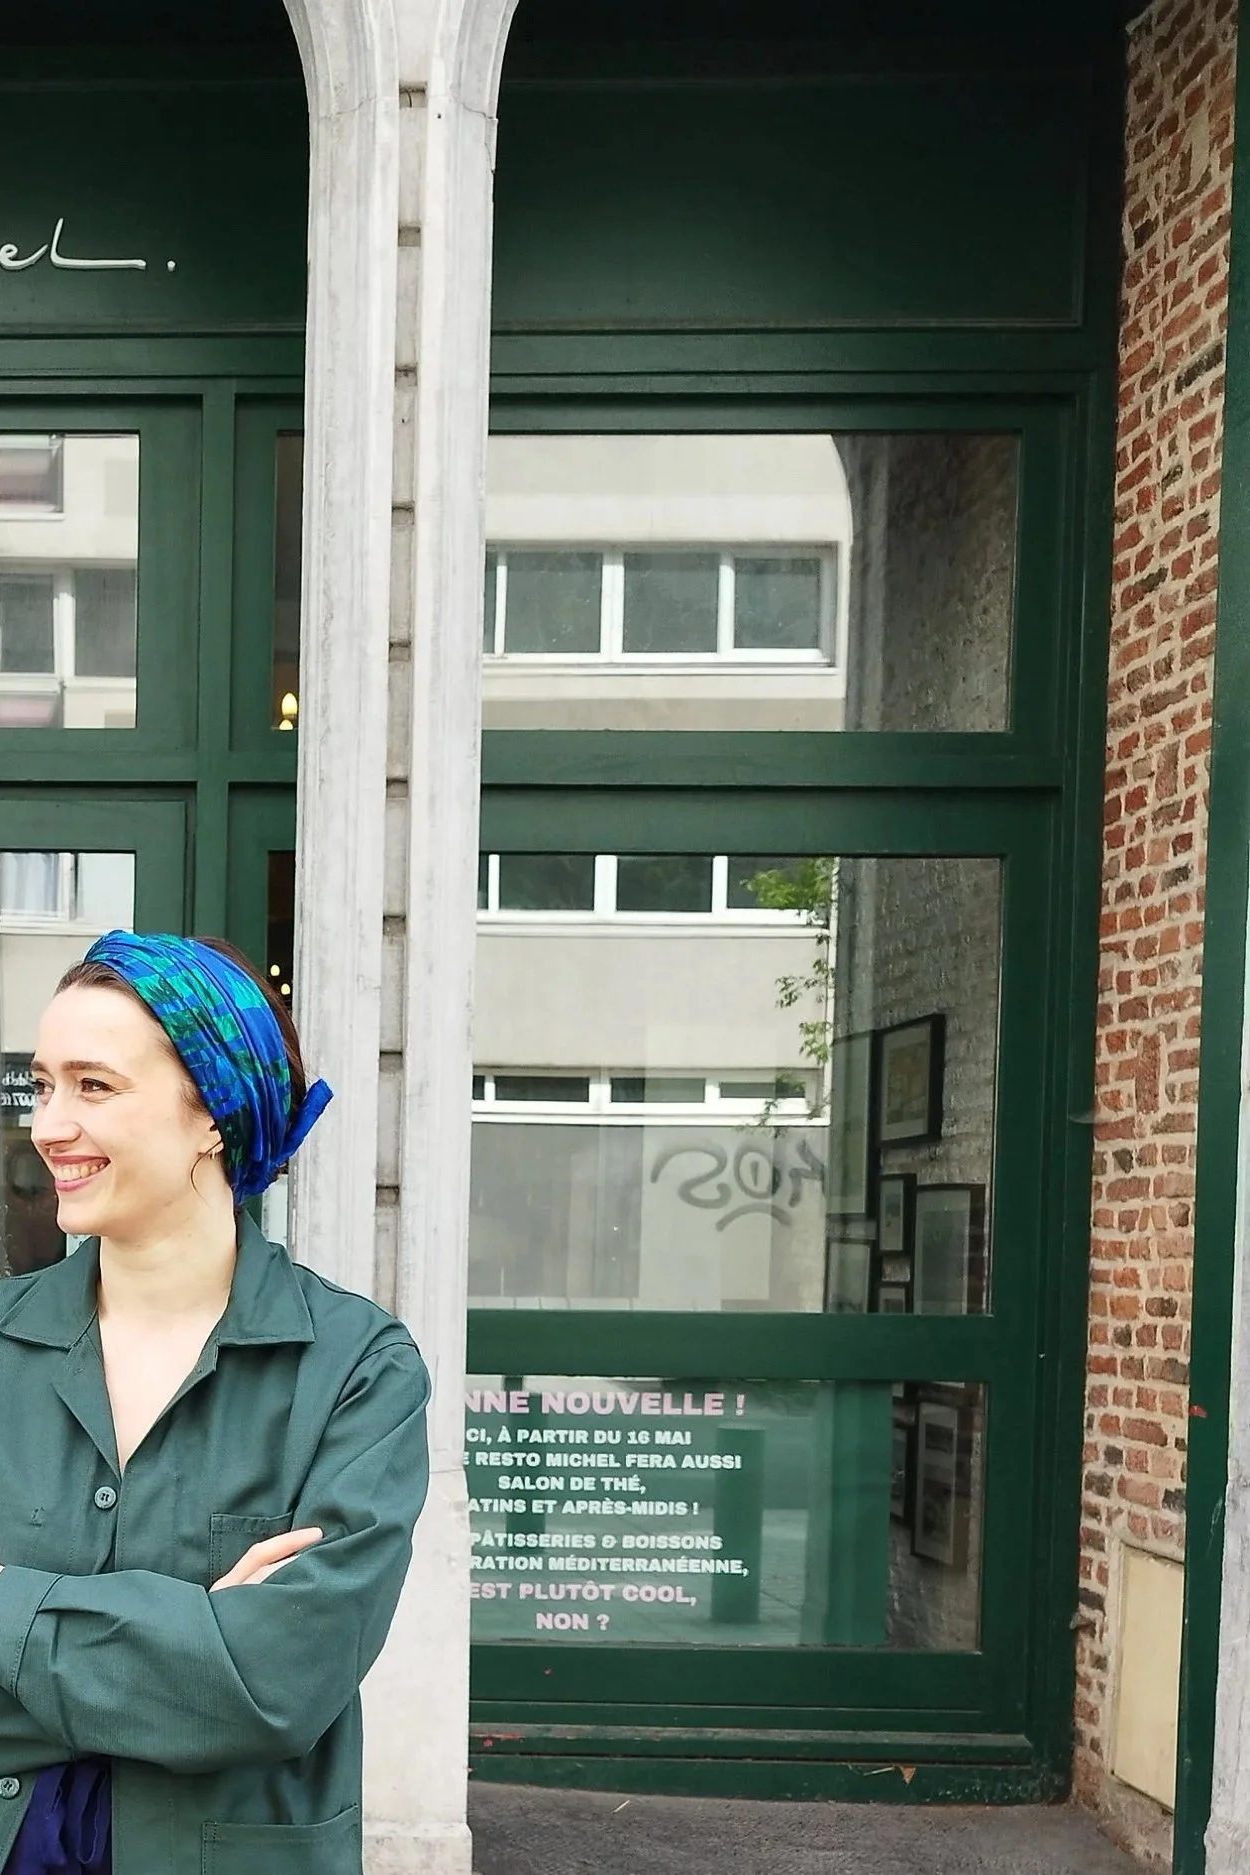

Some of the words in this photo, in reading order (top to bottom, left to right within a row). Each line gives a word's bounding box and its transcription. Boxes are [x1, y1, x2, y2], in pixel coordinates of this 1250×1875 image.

[541, 1391, 725, 1416] NOUVELLE
[497, 1425, 511, 1443] À
[516, 1429, 589, 1444] PARTIR
[594, 1429, 622, 1444] DU
[627, 1430, 650, 1445] 16
[655, 1431, 692, 1445] MAI
[475, 1451, 541, 1467] RESTO
[546, 1453, 621, 1468] MICHEL
[626, 1454, 677, 1469] FERA
[681, 1455, 743, 1470] AUSSI
[498, 1475, 565, 1491] SALON
[570, 1476, 596, 1491] DE
[600, 1474, 647, 1495] THÉ,
[532, 1500, 557, 1514] ET
[562, 1497, 688, 1516] APRÈS-MIDIS
[470, 1529, 597, 1549] PÂTISSERIES
[602, 1535, 618, 1549] &
[622, 1535, 723, 1550] BOISSONS
[548, 1554, 750, 1577] MÉDITERRANÉENNE,
[519, 1580, 616, 1602] PLUTÔT
[622, 1584, 698, 1607] COOL,
[535, 1612, 590, 1631] NON
[596, 1614, 611, 1632] ?
